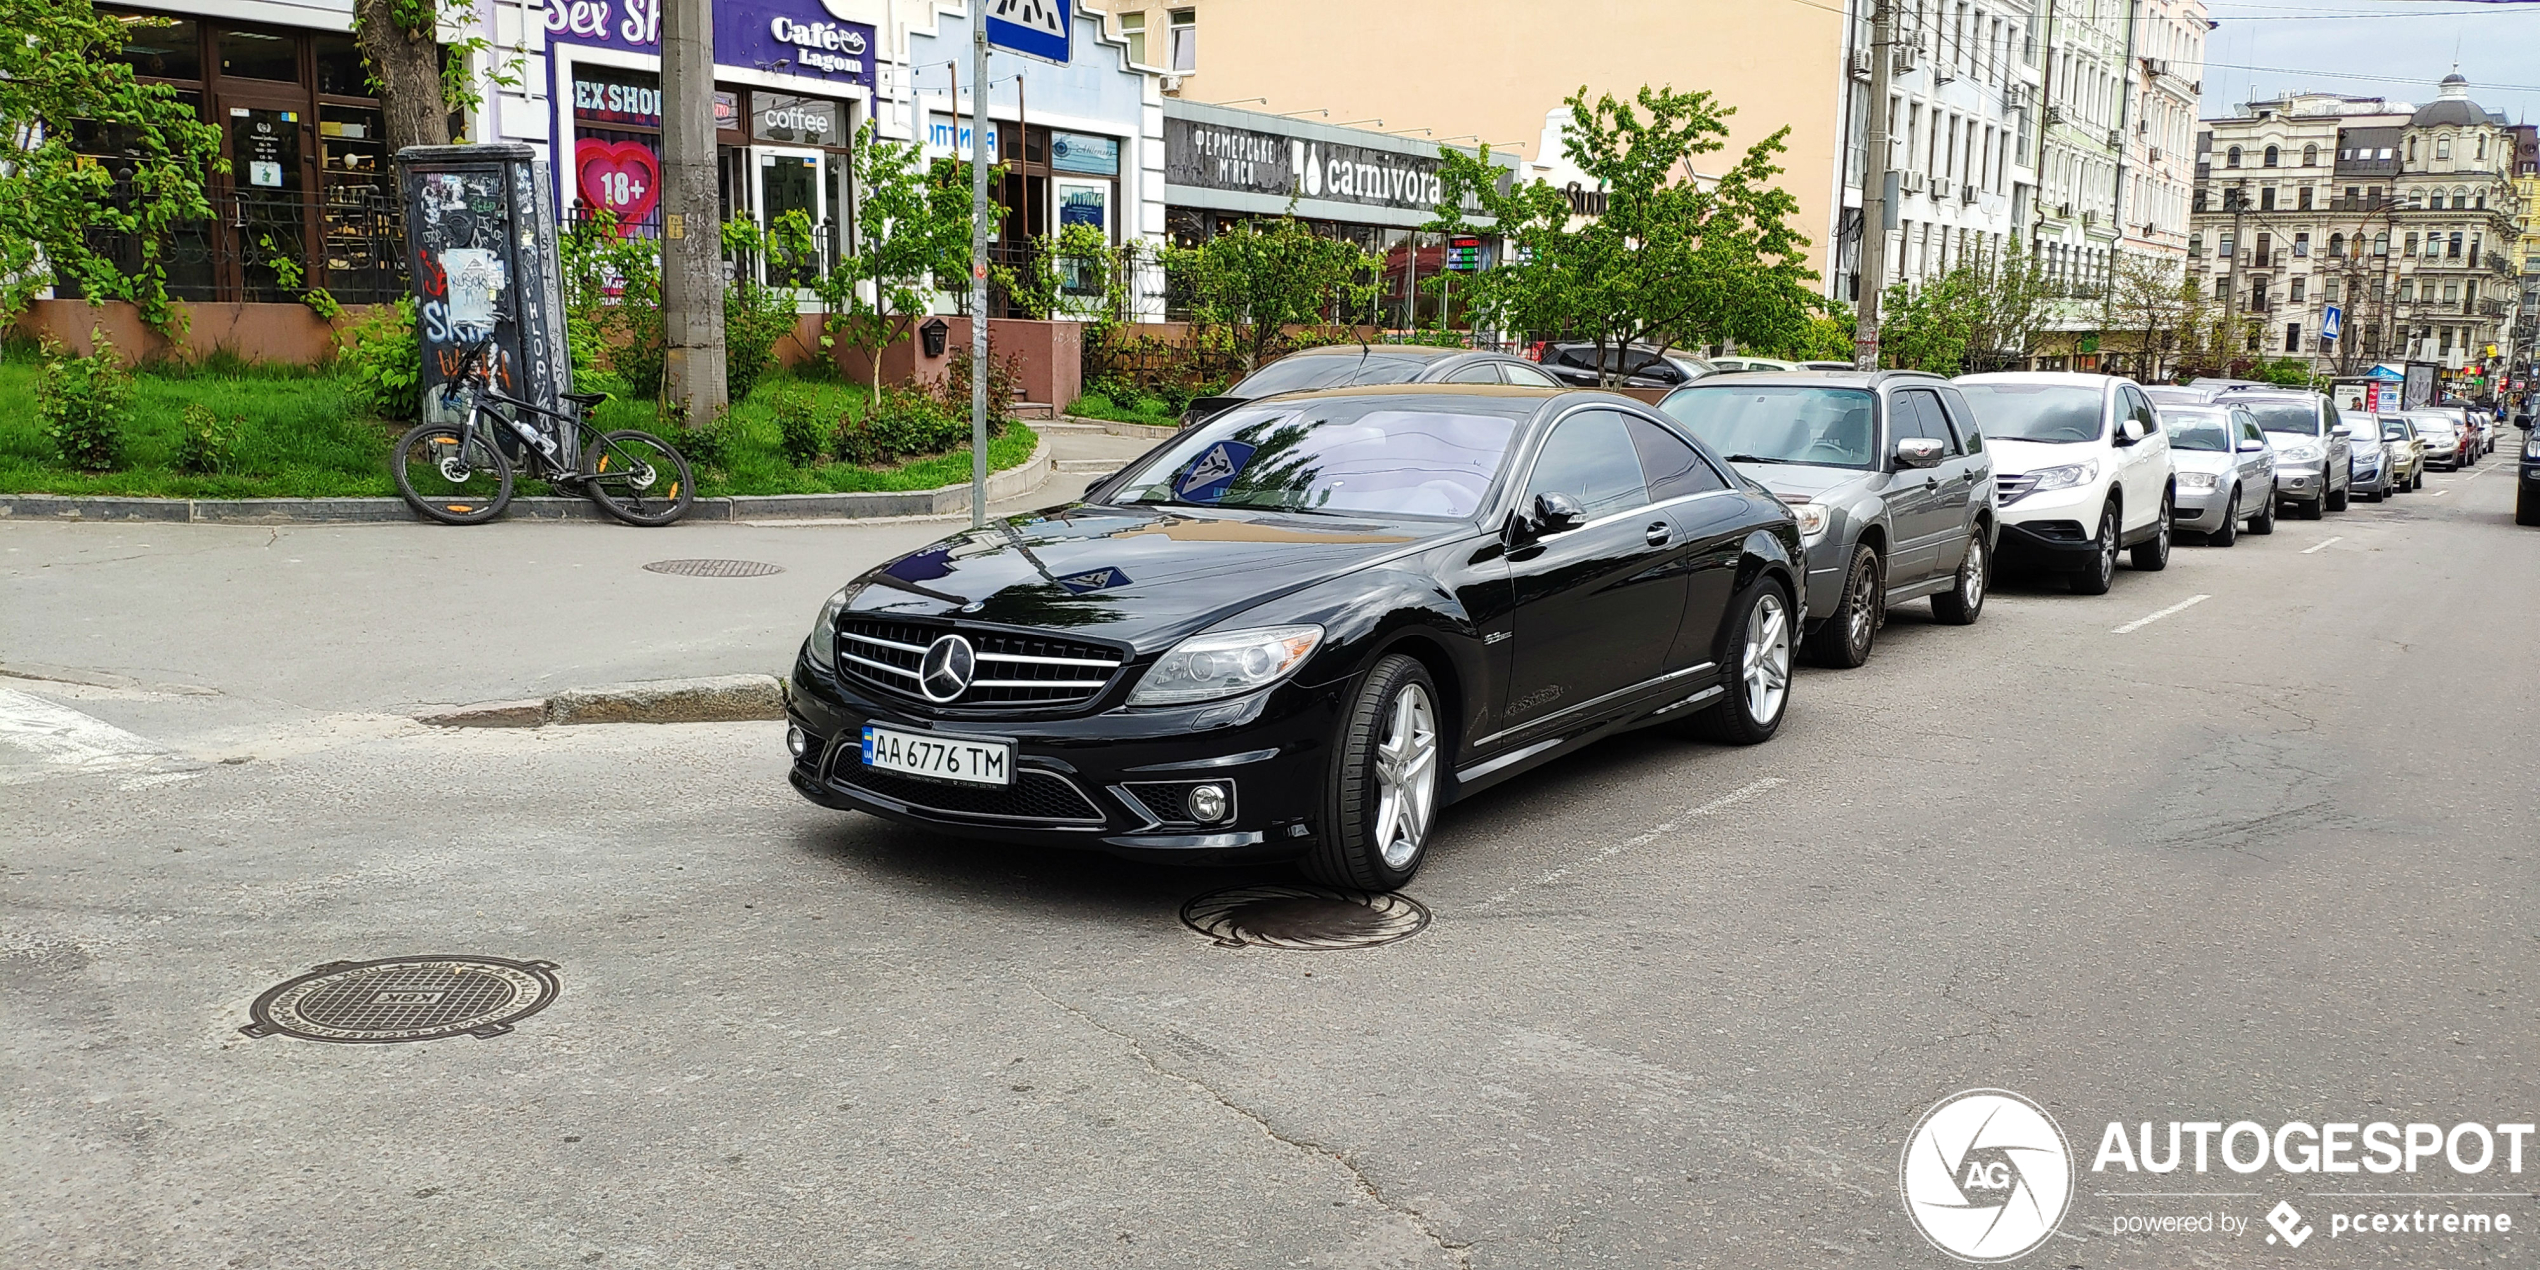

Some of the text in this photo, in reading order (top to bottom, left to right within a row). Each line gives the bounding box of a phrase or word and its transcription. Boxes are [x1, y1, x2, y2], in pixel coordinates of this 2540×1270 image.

[771, 16, 839, 50] Café
[798, 48, 863, 73] Lagom
[574, 80, 605, 110] EX
[765, 106, 829, 133] coffee
[1194, 130, 1274, 164] ФЕРМЕРСЬКЕ
[1218, 158, 1254, 185] М'ЯСО
[1327, 154, 1441, 204] carnivora
[601, 171, 645, 205] 18+
[864, 750, 872, 760] UA
[875, 734, 1003, 778] AA 6776 TM
